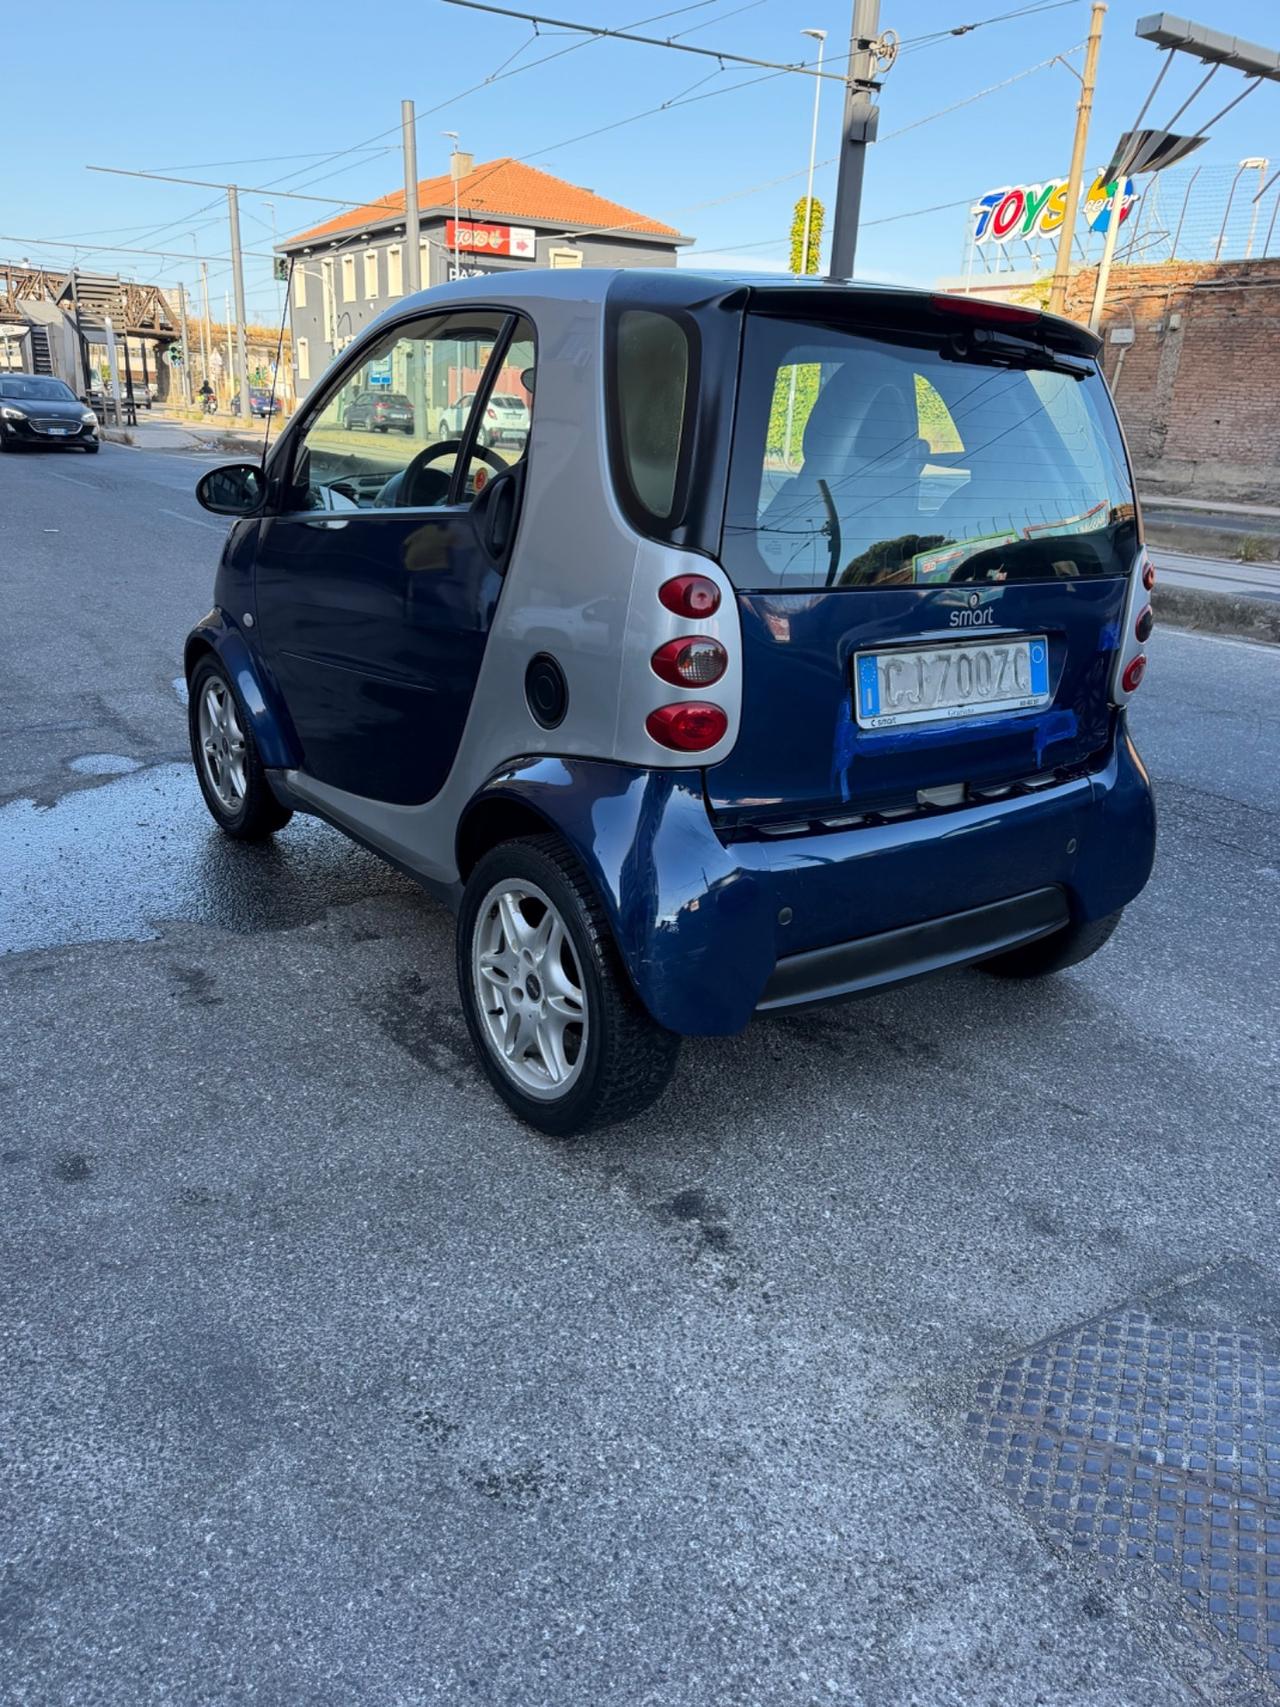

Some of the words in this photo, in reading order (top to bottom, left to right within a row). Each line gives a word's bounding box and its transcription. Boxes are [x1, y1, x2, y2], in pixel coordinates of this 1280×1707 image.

[972, 179, 1083, 244] TOYS
[1083, 192, 1140, 213] cener
[950, 607, 993, 627] smart
